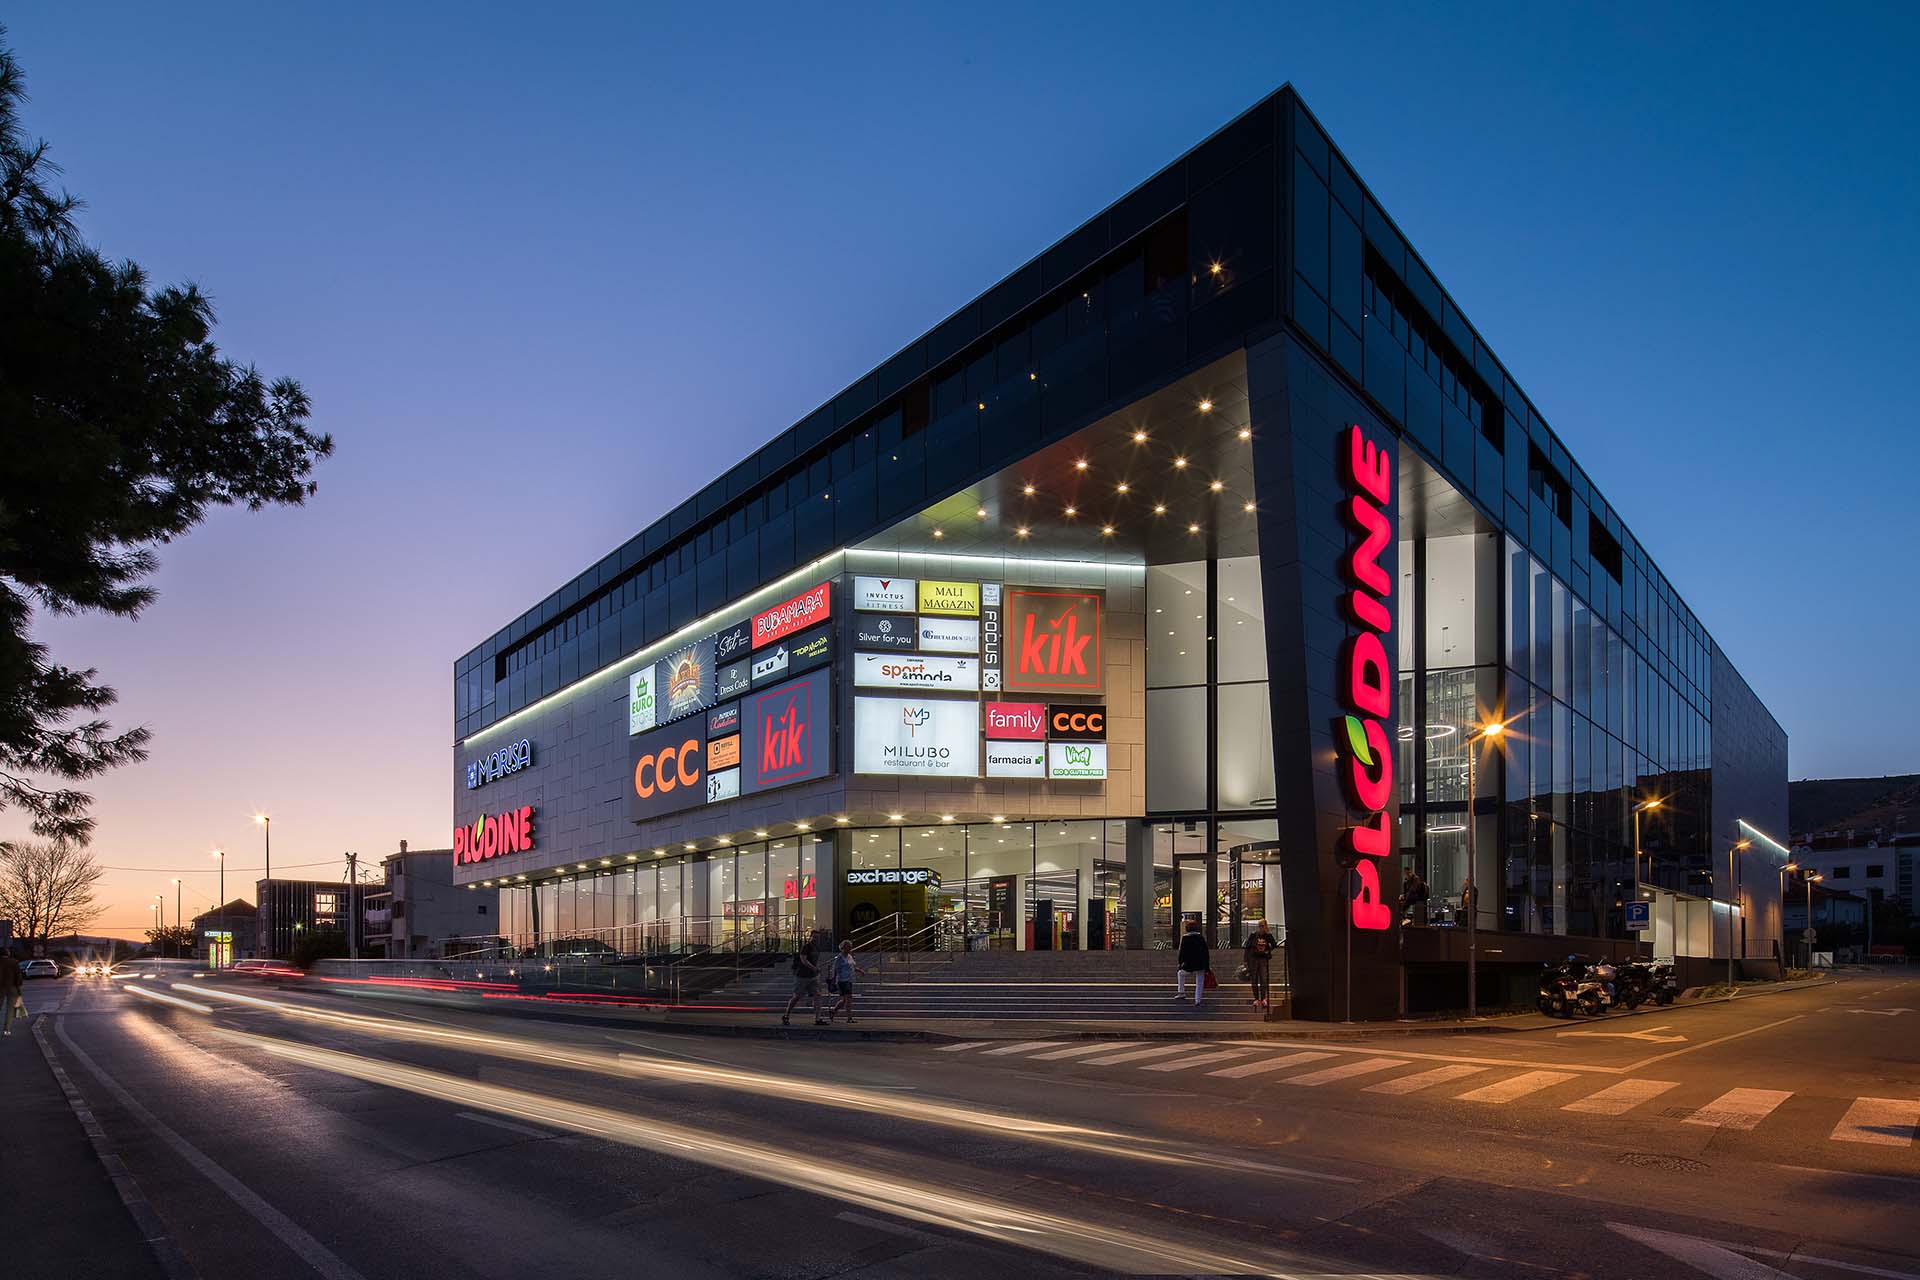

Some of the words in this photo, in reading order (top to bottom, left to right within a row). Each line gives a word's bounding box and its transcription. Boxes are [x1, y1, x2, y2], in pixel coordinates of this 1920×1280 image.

[935, 587, 963, 597] MALI
[924, 599, 975, 609] MAGAZIN
[757, 591, 824, 637] BUBAMARA
[858, 633, 881, 642] Silver
[882, 634, 895, 643] for
[897, 636, 912, 645] you
[985, 610, 998, 665] FOCUS
[1019, 603, 1092, 675] kik
[757, 661, 774, 674] LU
[881, 664, 925, 679] sport
[1350, 424, 1392, 930] PLODINE
[720, 684, 734, 695] Dress
[734, 678, 749, 690] Code
[631, 694, 653, 715] EURO
[989, 709, 1042, 733] family
[1053, 712, 1103, 732] CCC
[762, 695, 805, 774] kik
[884, 745, 950, 759] MILUBO
[988, 754, 1032, 765] farmacia
[478, 738, 531, 786] MARISA
[635, 739, 699, 799] CCC
[883, 759, 925, 767] restaurant
[935, 760, 950, 768] bar
[453, 805, 533, 866] PLODINE
[847, 869, 928, 885] exchange
[1632, 908, 1642, 920] P
